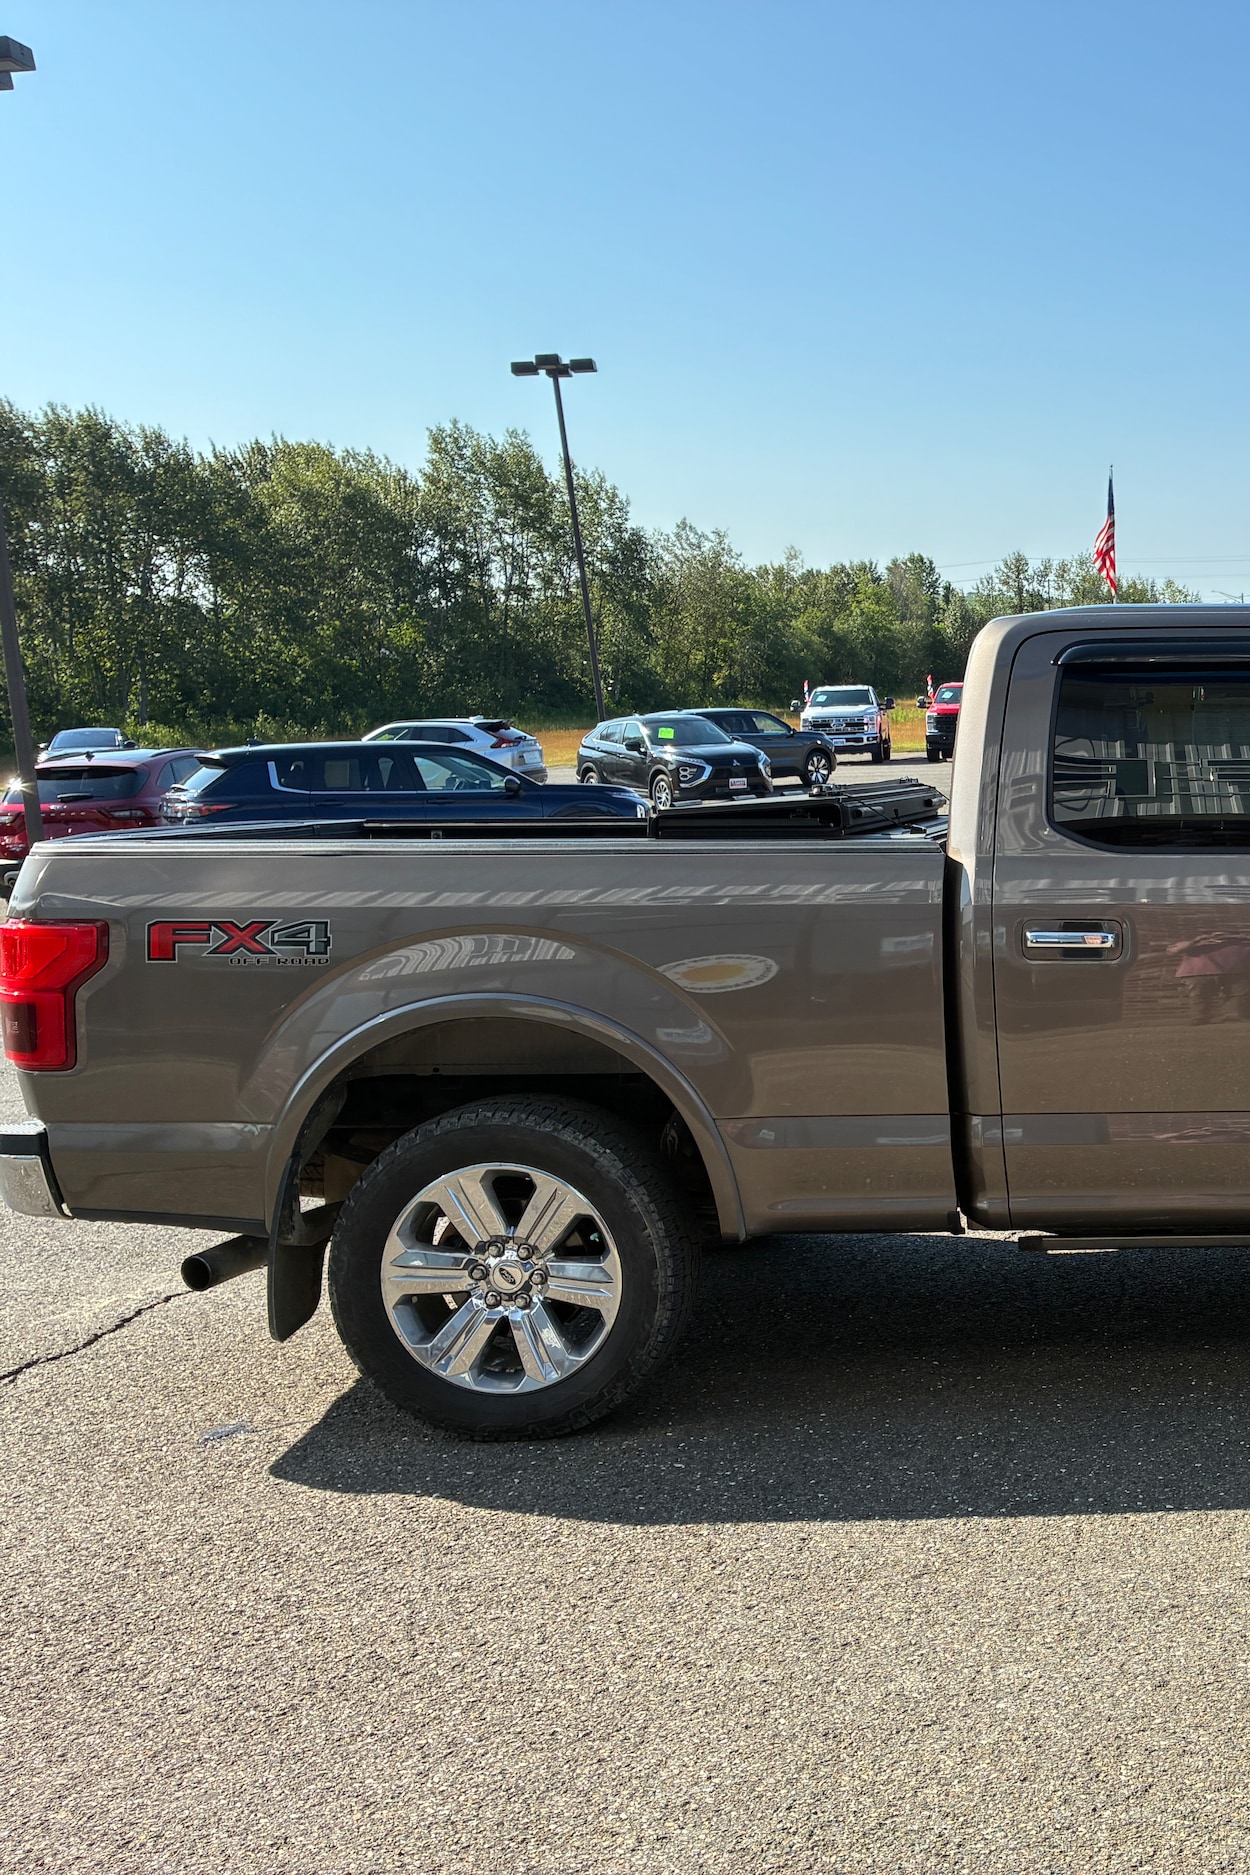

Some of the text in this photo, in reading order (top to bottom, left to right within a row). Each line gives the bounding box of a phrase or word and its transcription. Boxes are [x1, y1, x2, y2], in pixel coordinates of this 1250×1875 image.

[146, 919, 332, 963] FX4
[230, 956, 330, 966] OFF ROAD
